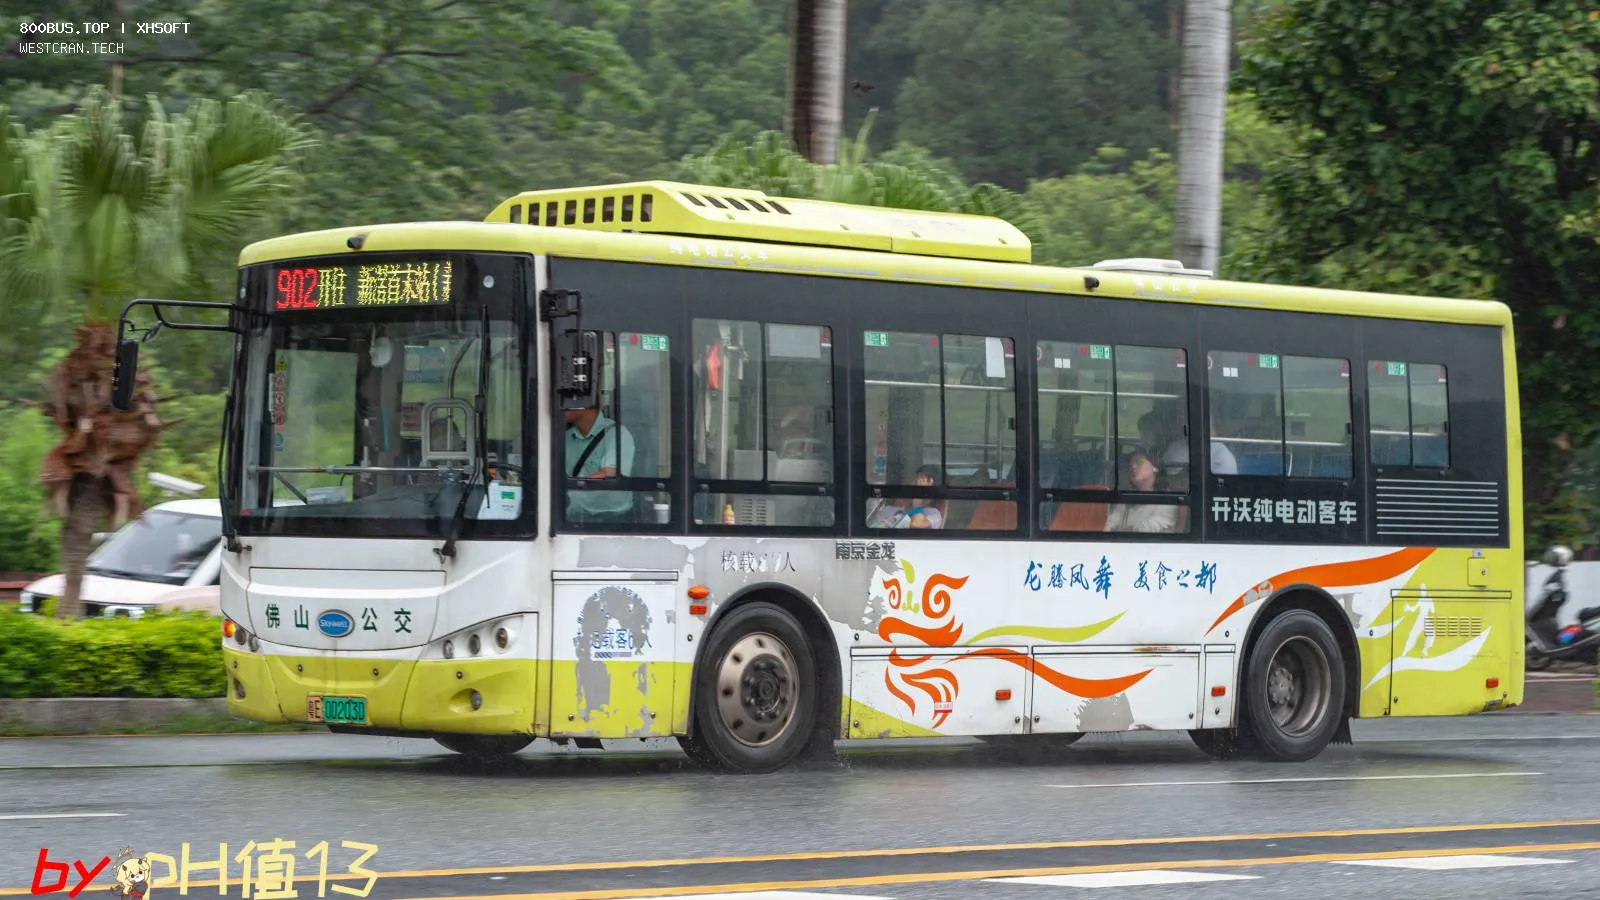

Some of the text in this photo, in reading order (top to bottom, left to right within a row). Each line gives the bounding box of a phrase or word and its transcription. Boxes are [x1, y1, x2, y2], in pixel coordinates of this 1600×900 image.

[276, 268, 318, 309] 902
[1211, 496, 1357, 525] 开沃纯电动客车
[835, 541, 896, 560] 南京金龙
[1024, 555, 1217, 600] 龙腾凤舞 美食之都
[265, 603, 310, 630] 佛山
[361, 607, 412, 634] 公交
